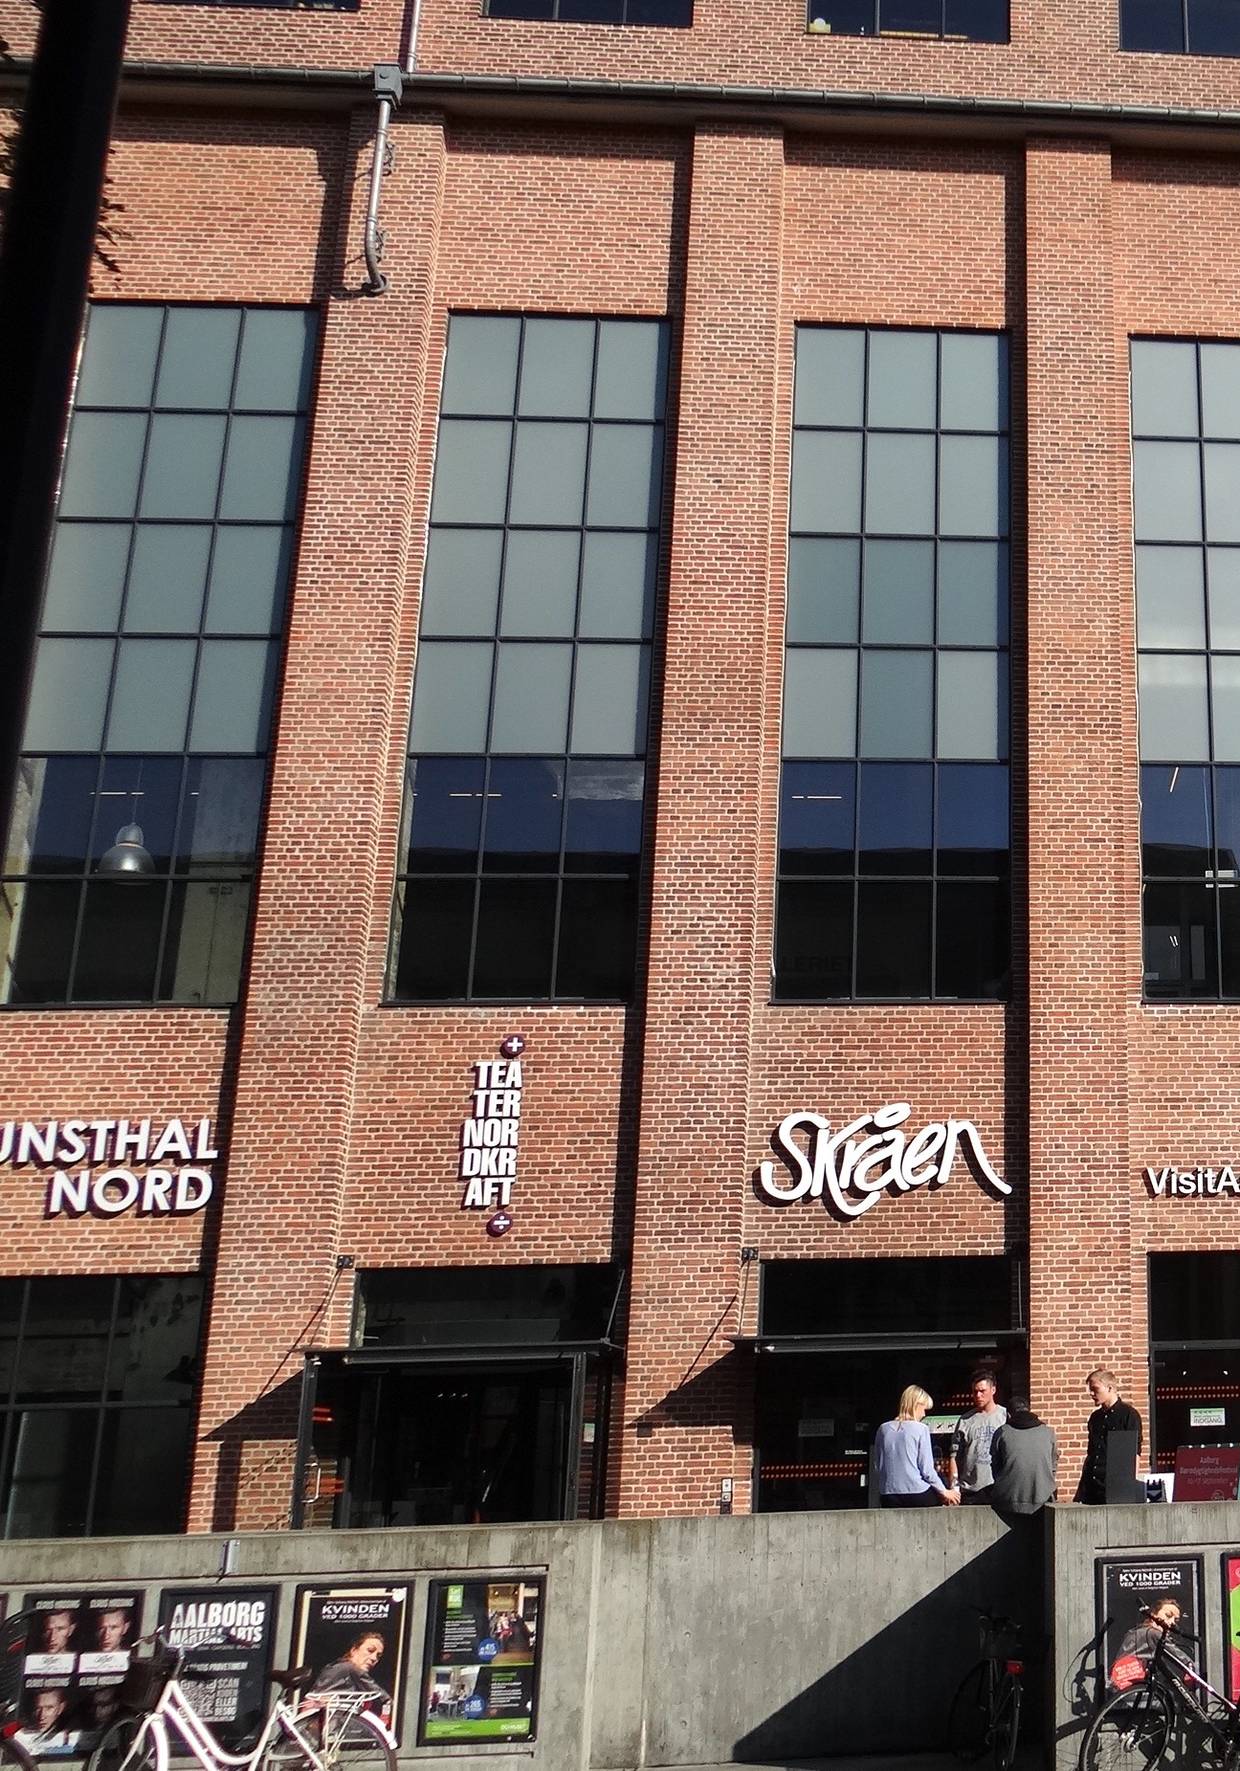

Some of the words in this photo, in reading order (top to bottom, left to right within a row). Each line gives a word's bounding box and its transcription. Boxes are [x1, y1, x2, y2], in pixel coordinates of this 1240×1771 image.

[475, 1061, 522, 1088] TEA
[474, 1089, 521, 1117] TER
[463, 1118, 519, 1147] NOR
[462, 1148, 517, 1176] DKR
[761, 1102, 1012, 1215] Skråen
[50, 1168, 213, 1212] NORD
[464, 1178, 515, 1206] AFT
[1120, 1571, 1181, 1581] KVINDEN
[322, 1604, 390, 1614] KVINDEN
